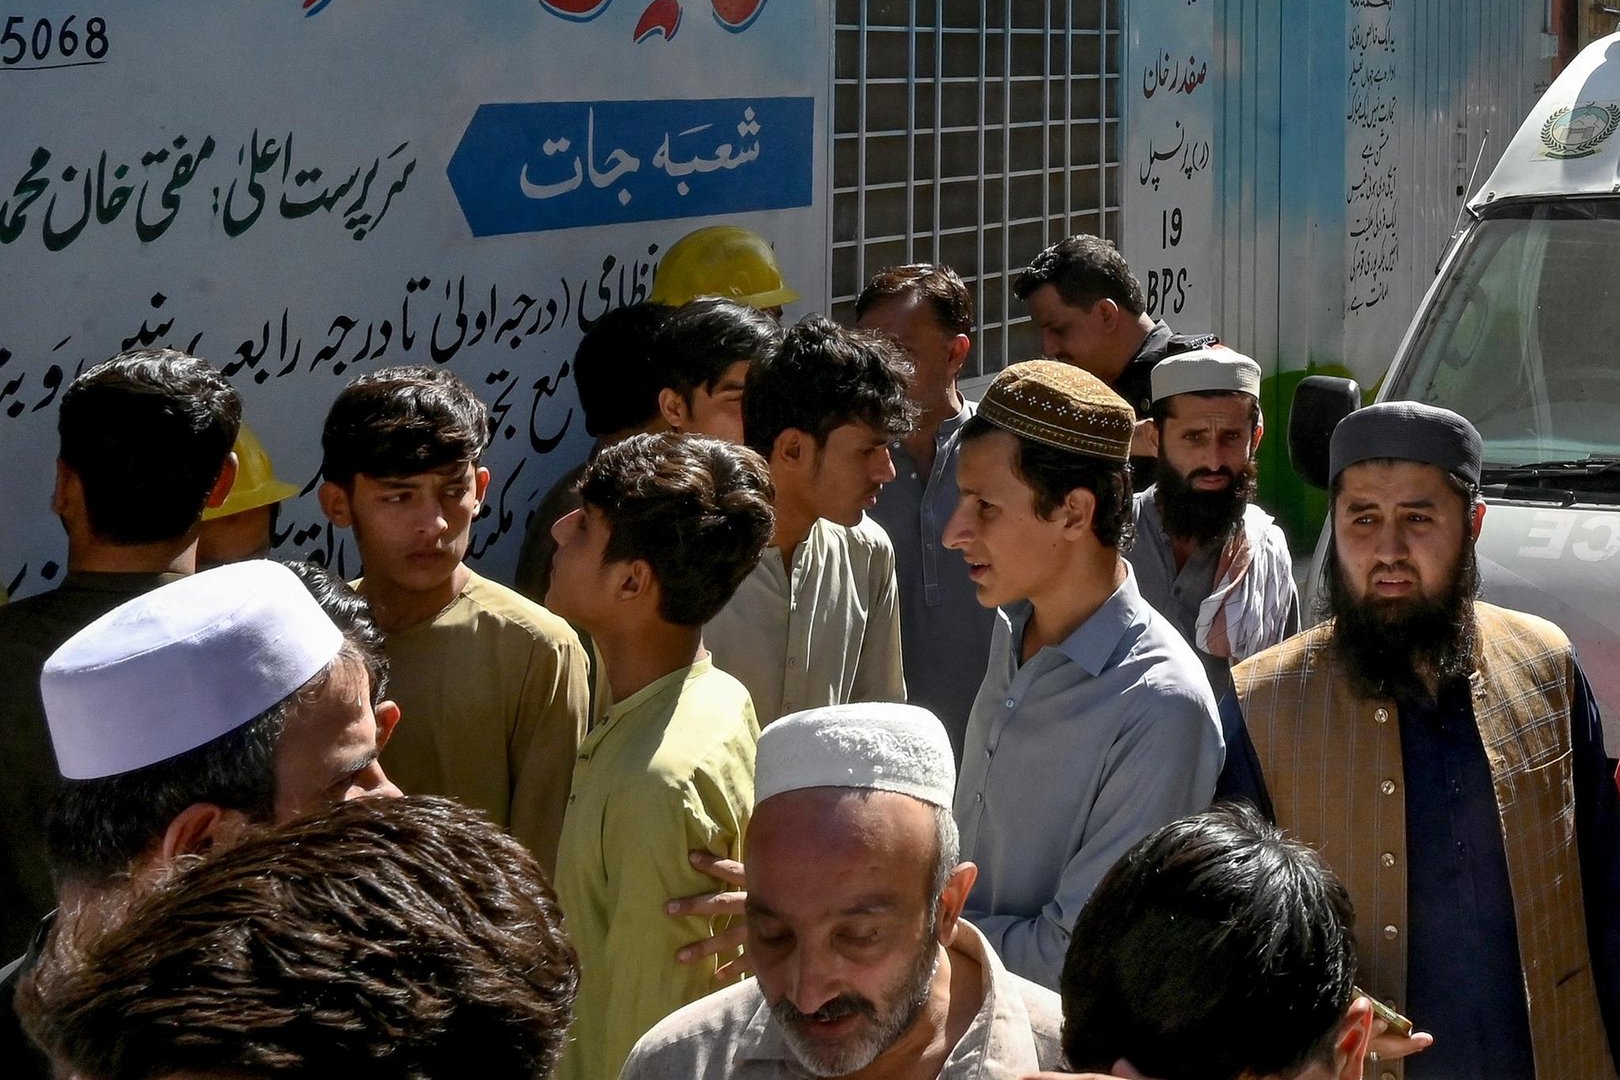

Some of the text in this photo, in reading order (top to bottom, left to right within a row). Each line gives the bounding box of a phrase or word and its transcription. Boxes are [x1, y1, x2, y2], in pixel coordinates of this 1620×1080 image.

[42, 148, 139, 253] خان
[519, 107, 641, 205] جات
[1162, 206, 1184, 250] 19
